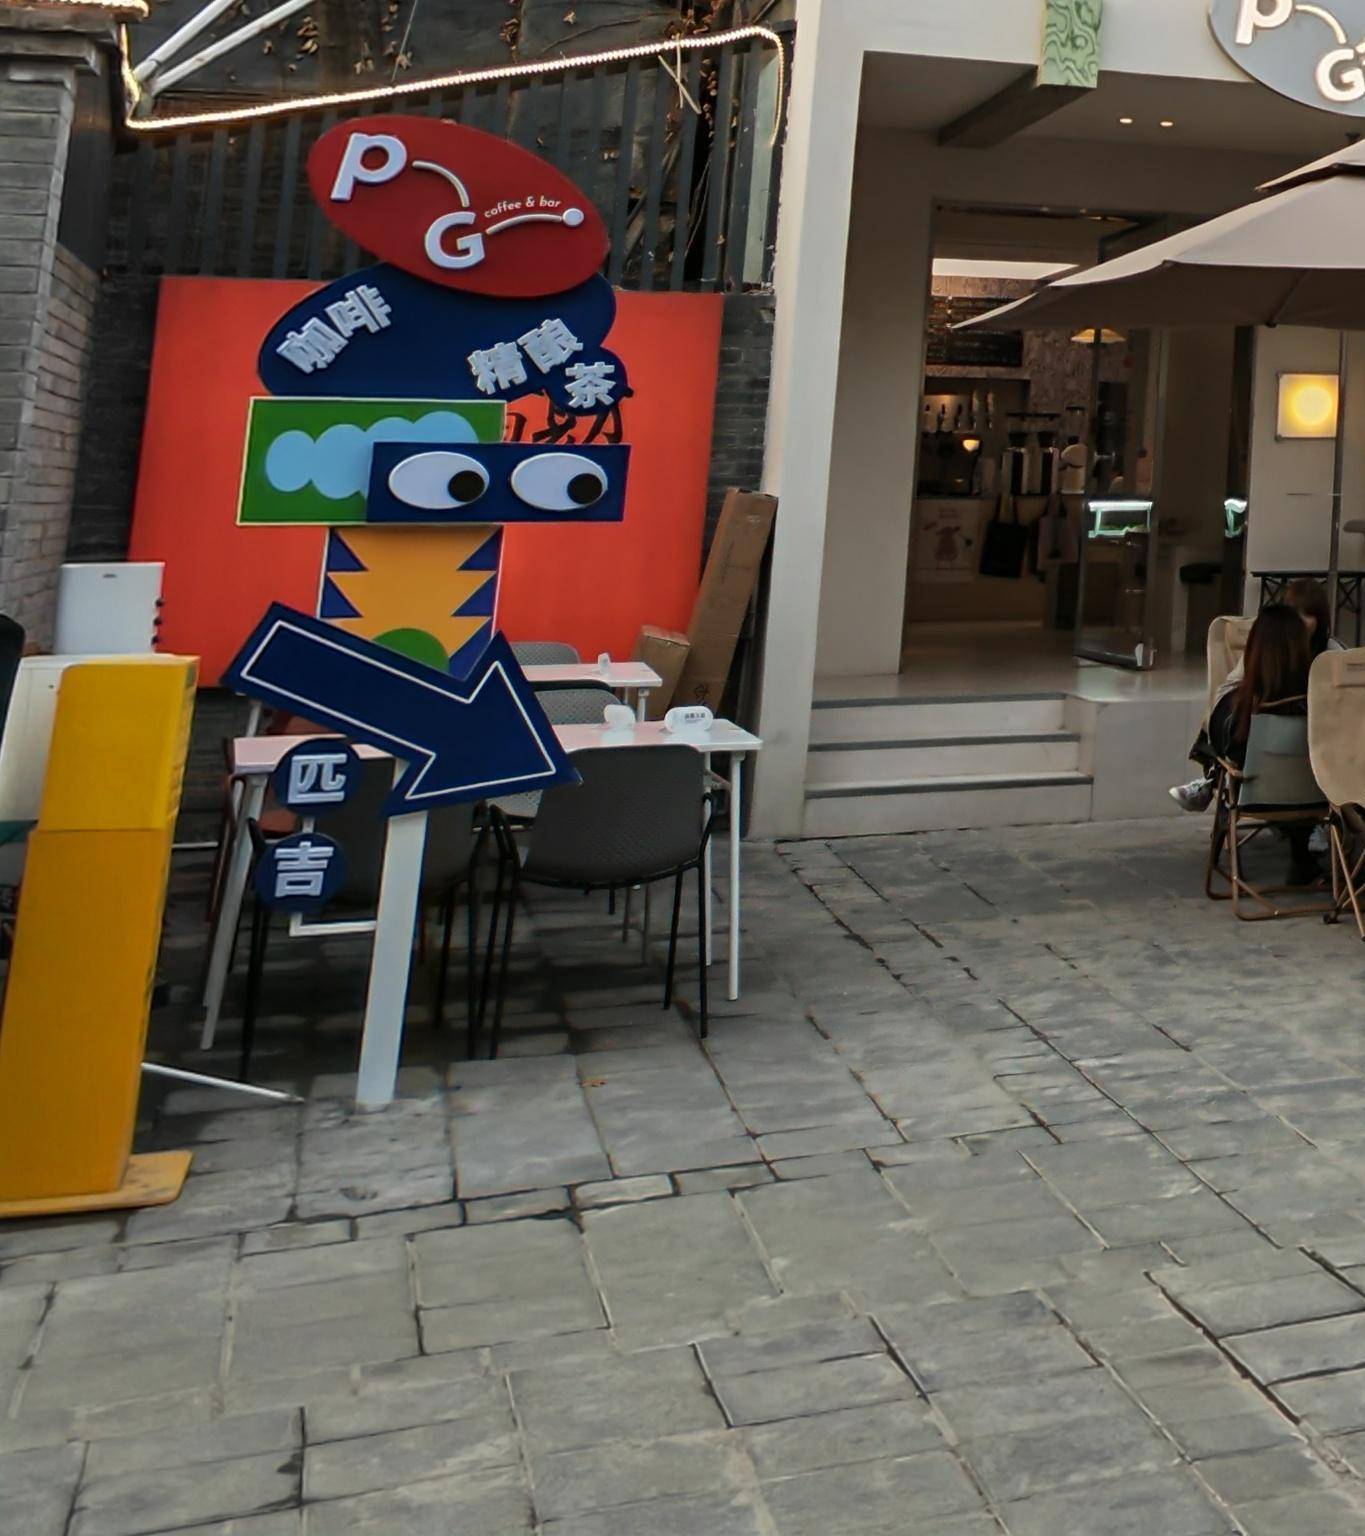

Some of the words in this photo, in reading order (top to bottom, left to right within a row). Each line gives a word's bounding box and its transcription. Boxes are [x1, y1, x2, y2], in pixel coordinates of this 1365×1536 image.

[484, 199, 522, 217] coffee
[539, 195, 562, 208] bar
[279, 284, 393, 375] 咖啡
[467, 318, 584, 395] 精酿
[564, 361, 616, 409] 茶
[275, 753, 348, 898] 匹吉
